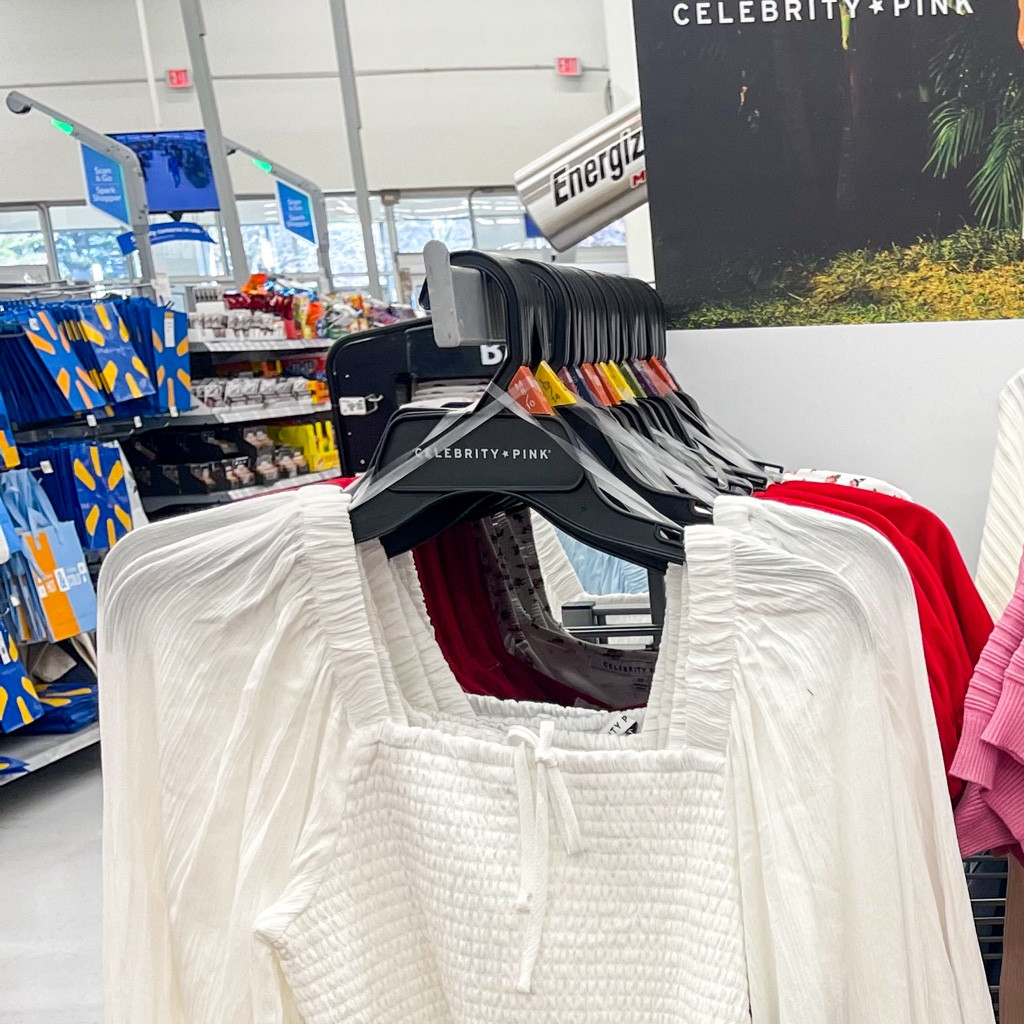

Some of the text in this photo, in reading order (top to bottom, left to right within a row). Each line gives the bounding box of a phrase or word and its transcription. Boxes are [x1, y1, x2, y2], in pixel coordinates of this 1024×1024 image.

[673, 0, 859, 25] CELEBRITY
[553, 130, 645, 207] Energiz
[414, 448, 549, 460] CELEBRITY PINK
[603, 661, 647, 673] CELEBRITY
